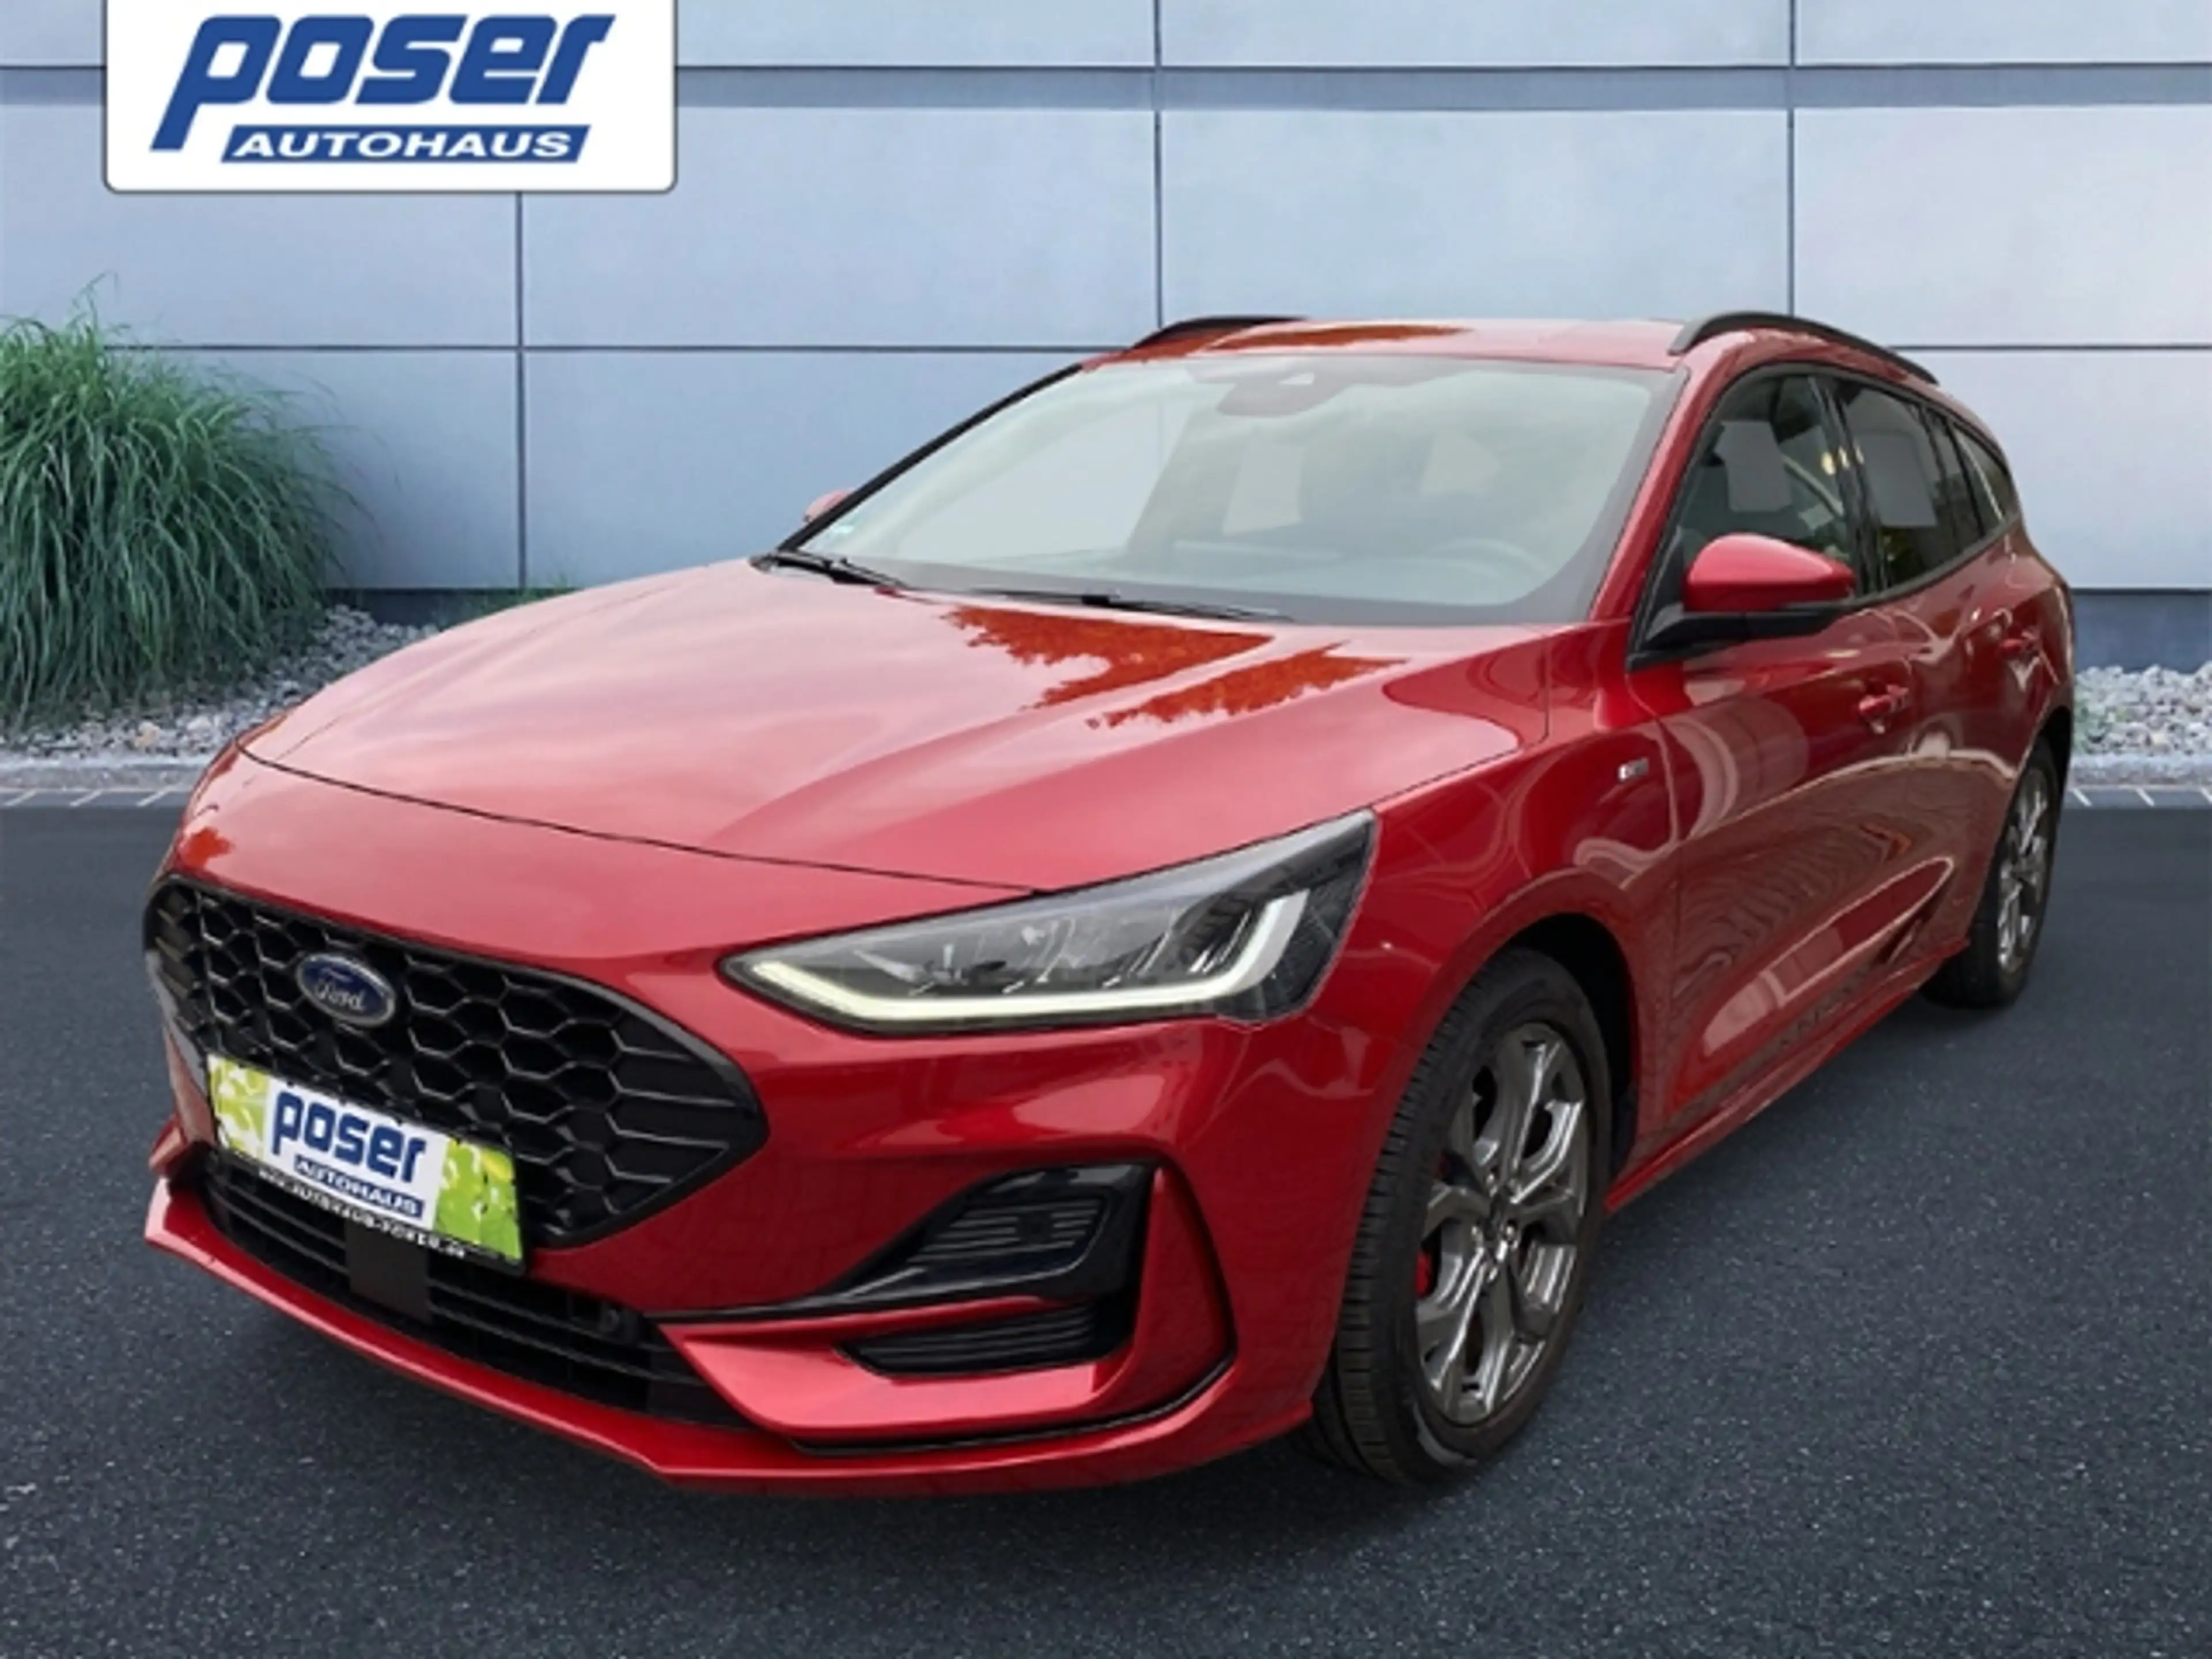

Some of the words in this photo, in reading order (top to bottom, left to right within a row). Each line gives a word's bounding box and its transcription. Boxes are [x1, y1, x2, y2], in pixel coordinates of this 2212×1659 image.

[315, 967, 367, 1013] Ford
[271, 1090, 427, 1183] poser
[296, 1160, 419, 1215] AUTOHAUS
